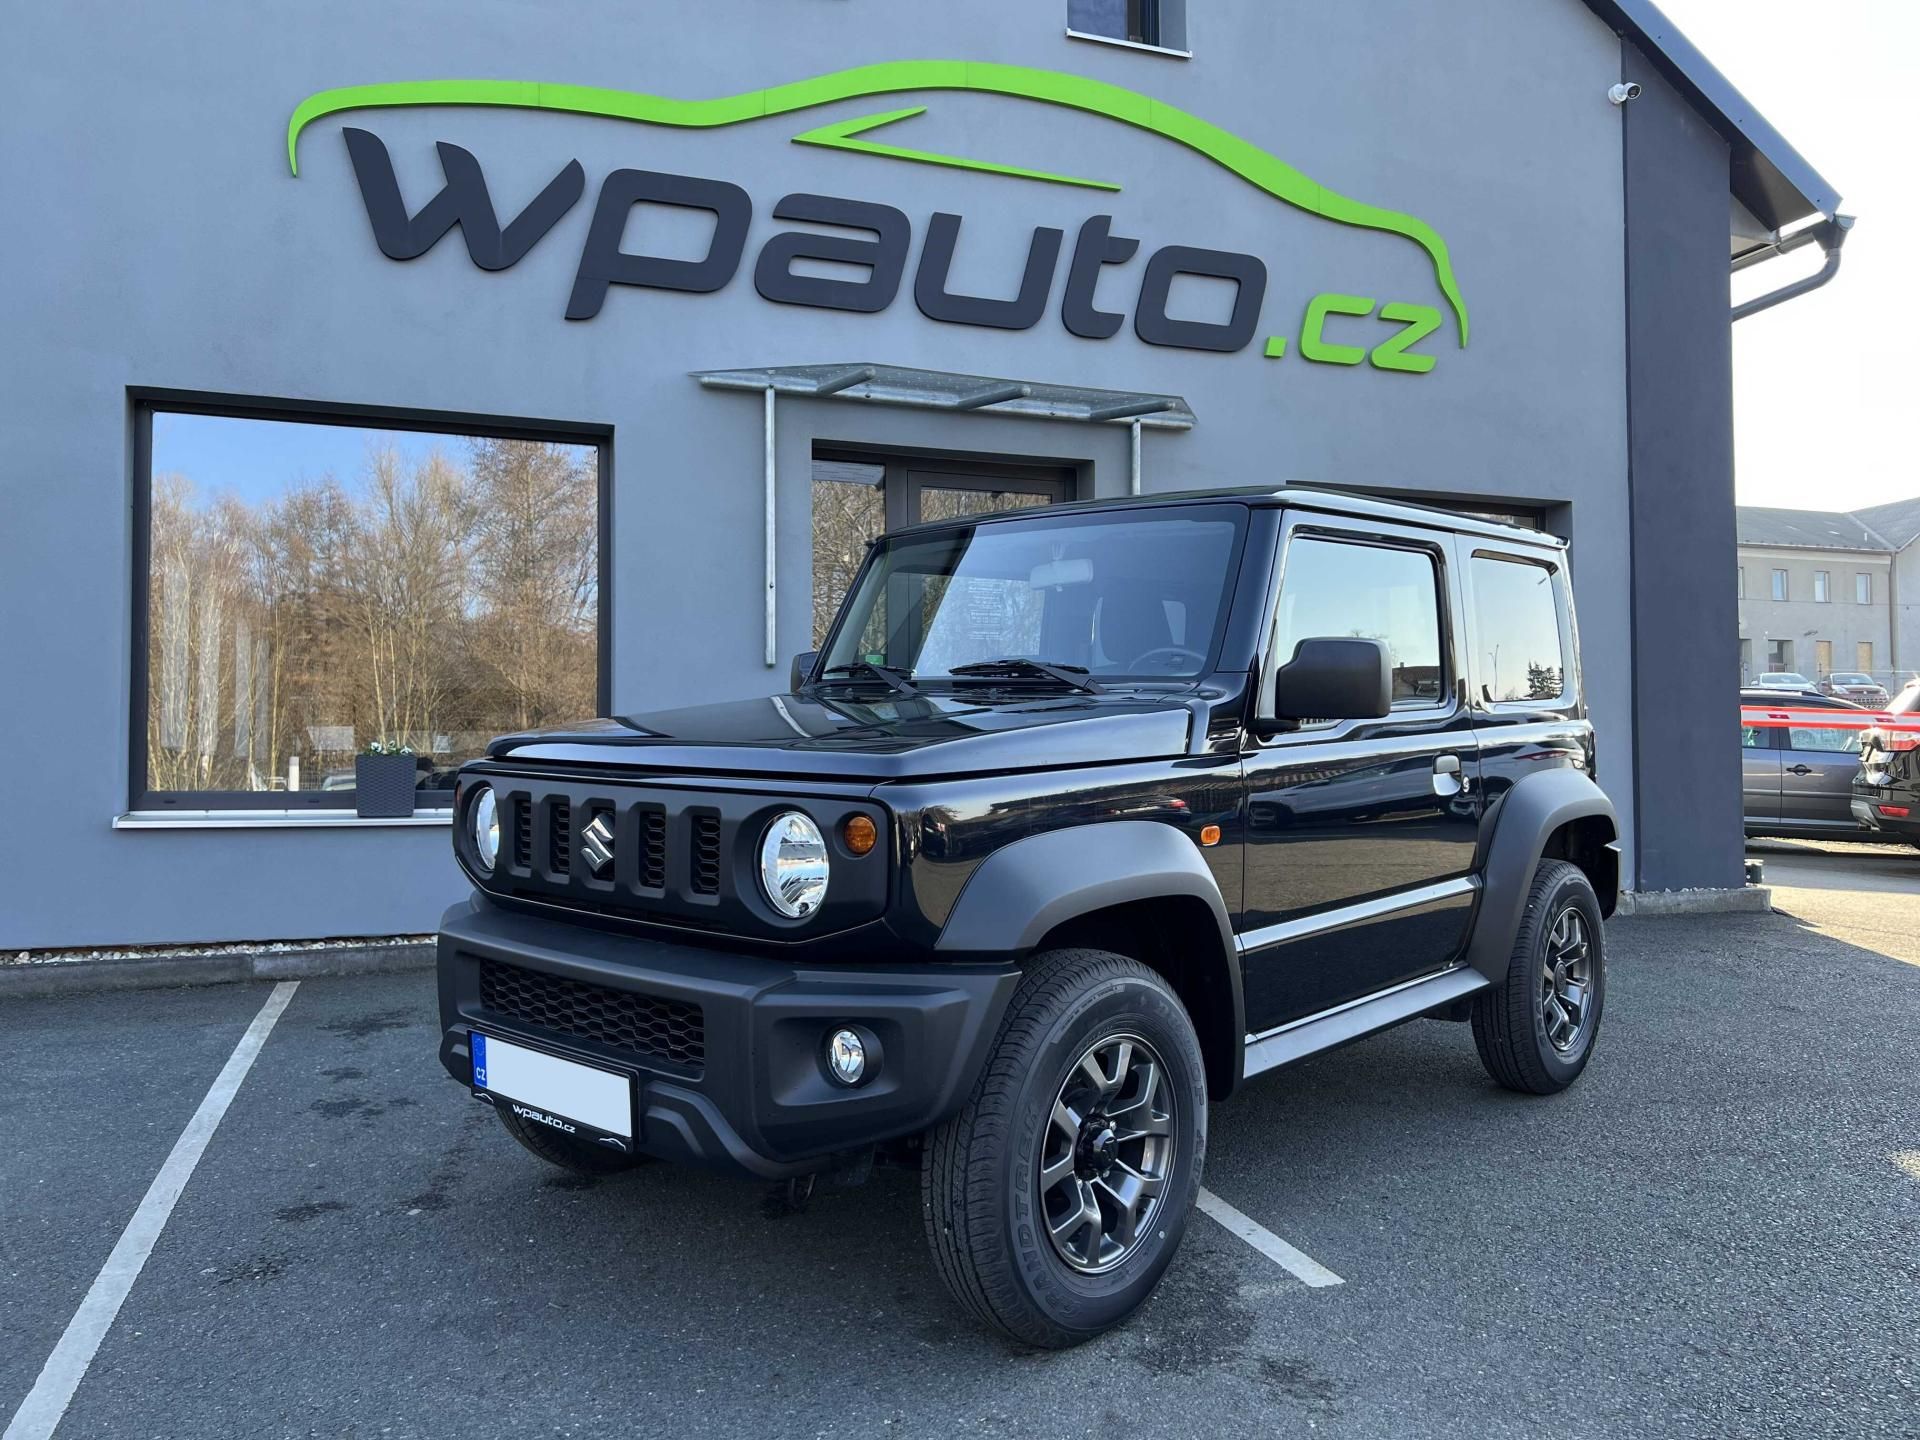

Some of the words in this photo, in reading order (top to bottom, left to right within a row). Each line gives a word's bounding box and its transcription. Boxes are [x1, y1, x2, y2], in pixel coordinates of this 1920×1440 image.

[342, 127, 1443, 373] wpauto.cz
[476, 1066, 486, 1081] CZ
[512, 1103, 576, 1134] wpauto.cz
